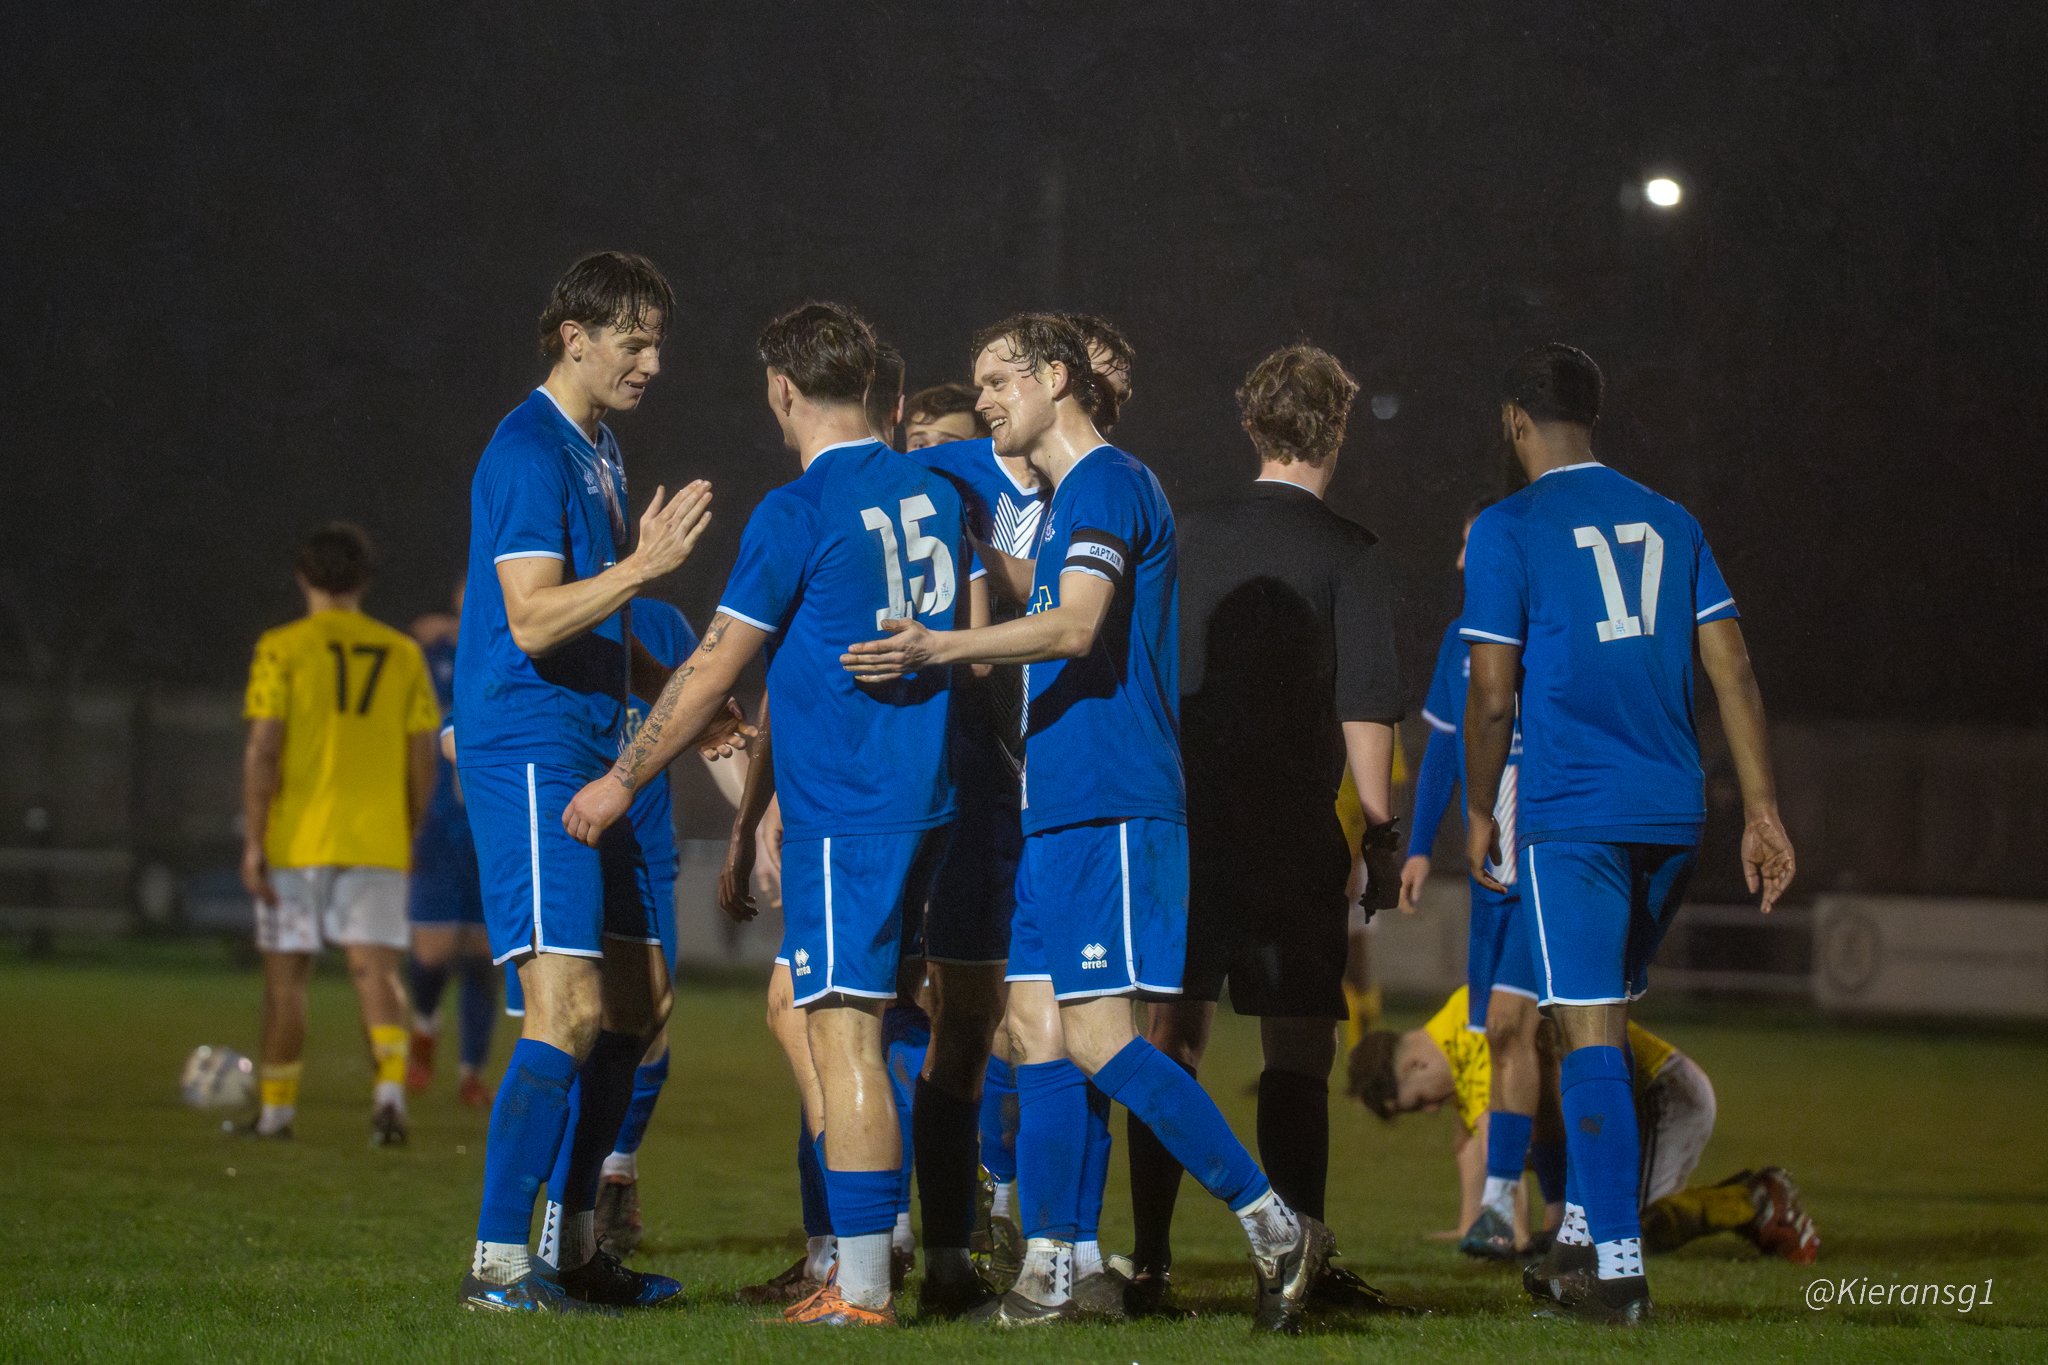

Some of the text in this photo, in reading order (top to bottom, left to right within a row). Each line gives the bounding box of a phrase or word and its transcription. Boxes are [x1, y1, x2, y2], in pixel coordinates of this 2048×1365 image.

[860, 493, 956, 631] 15
[1089, 545, 1121, 567] CAPTAIN
[1573, 522, 1664, 643] 17
[327, 641, 389, 715] 17
